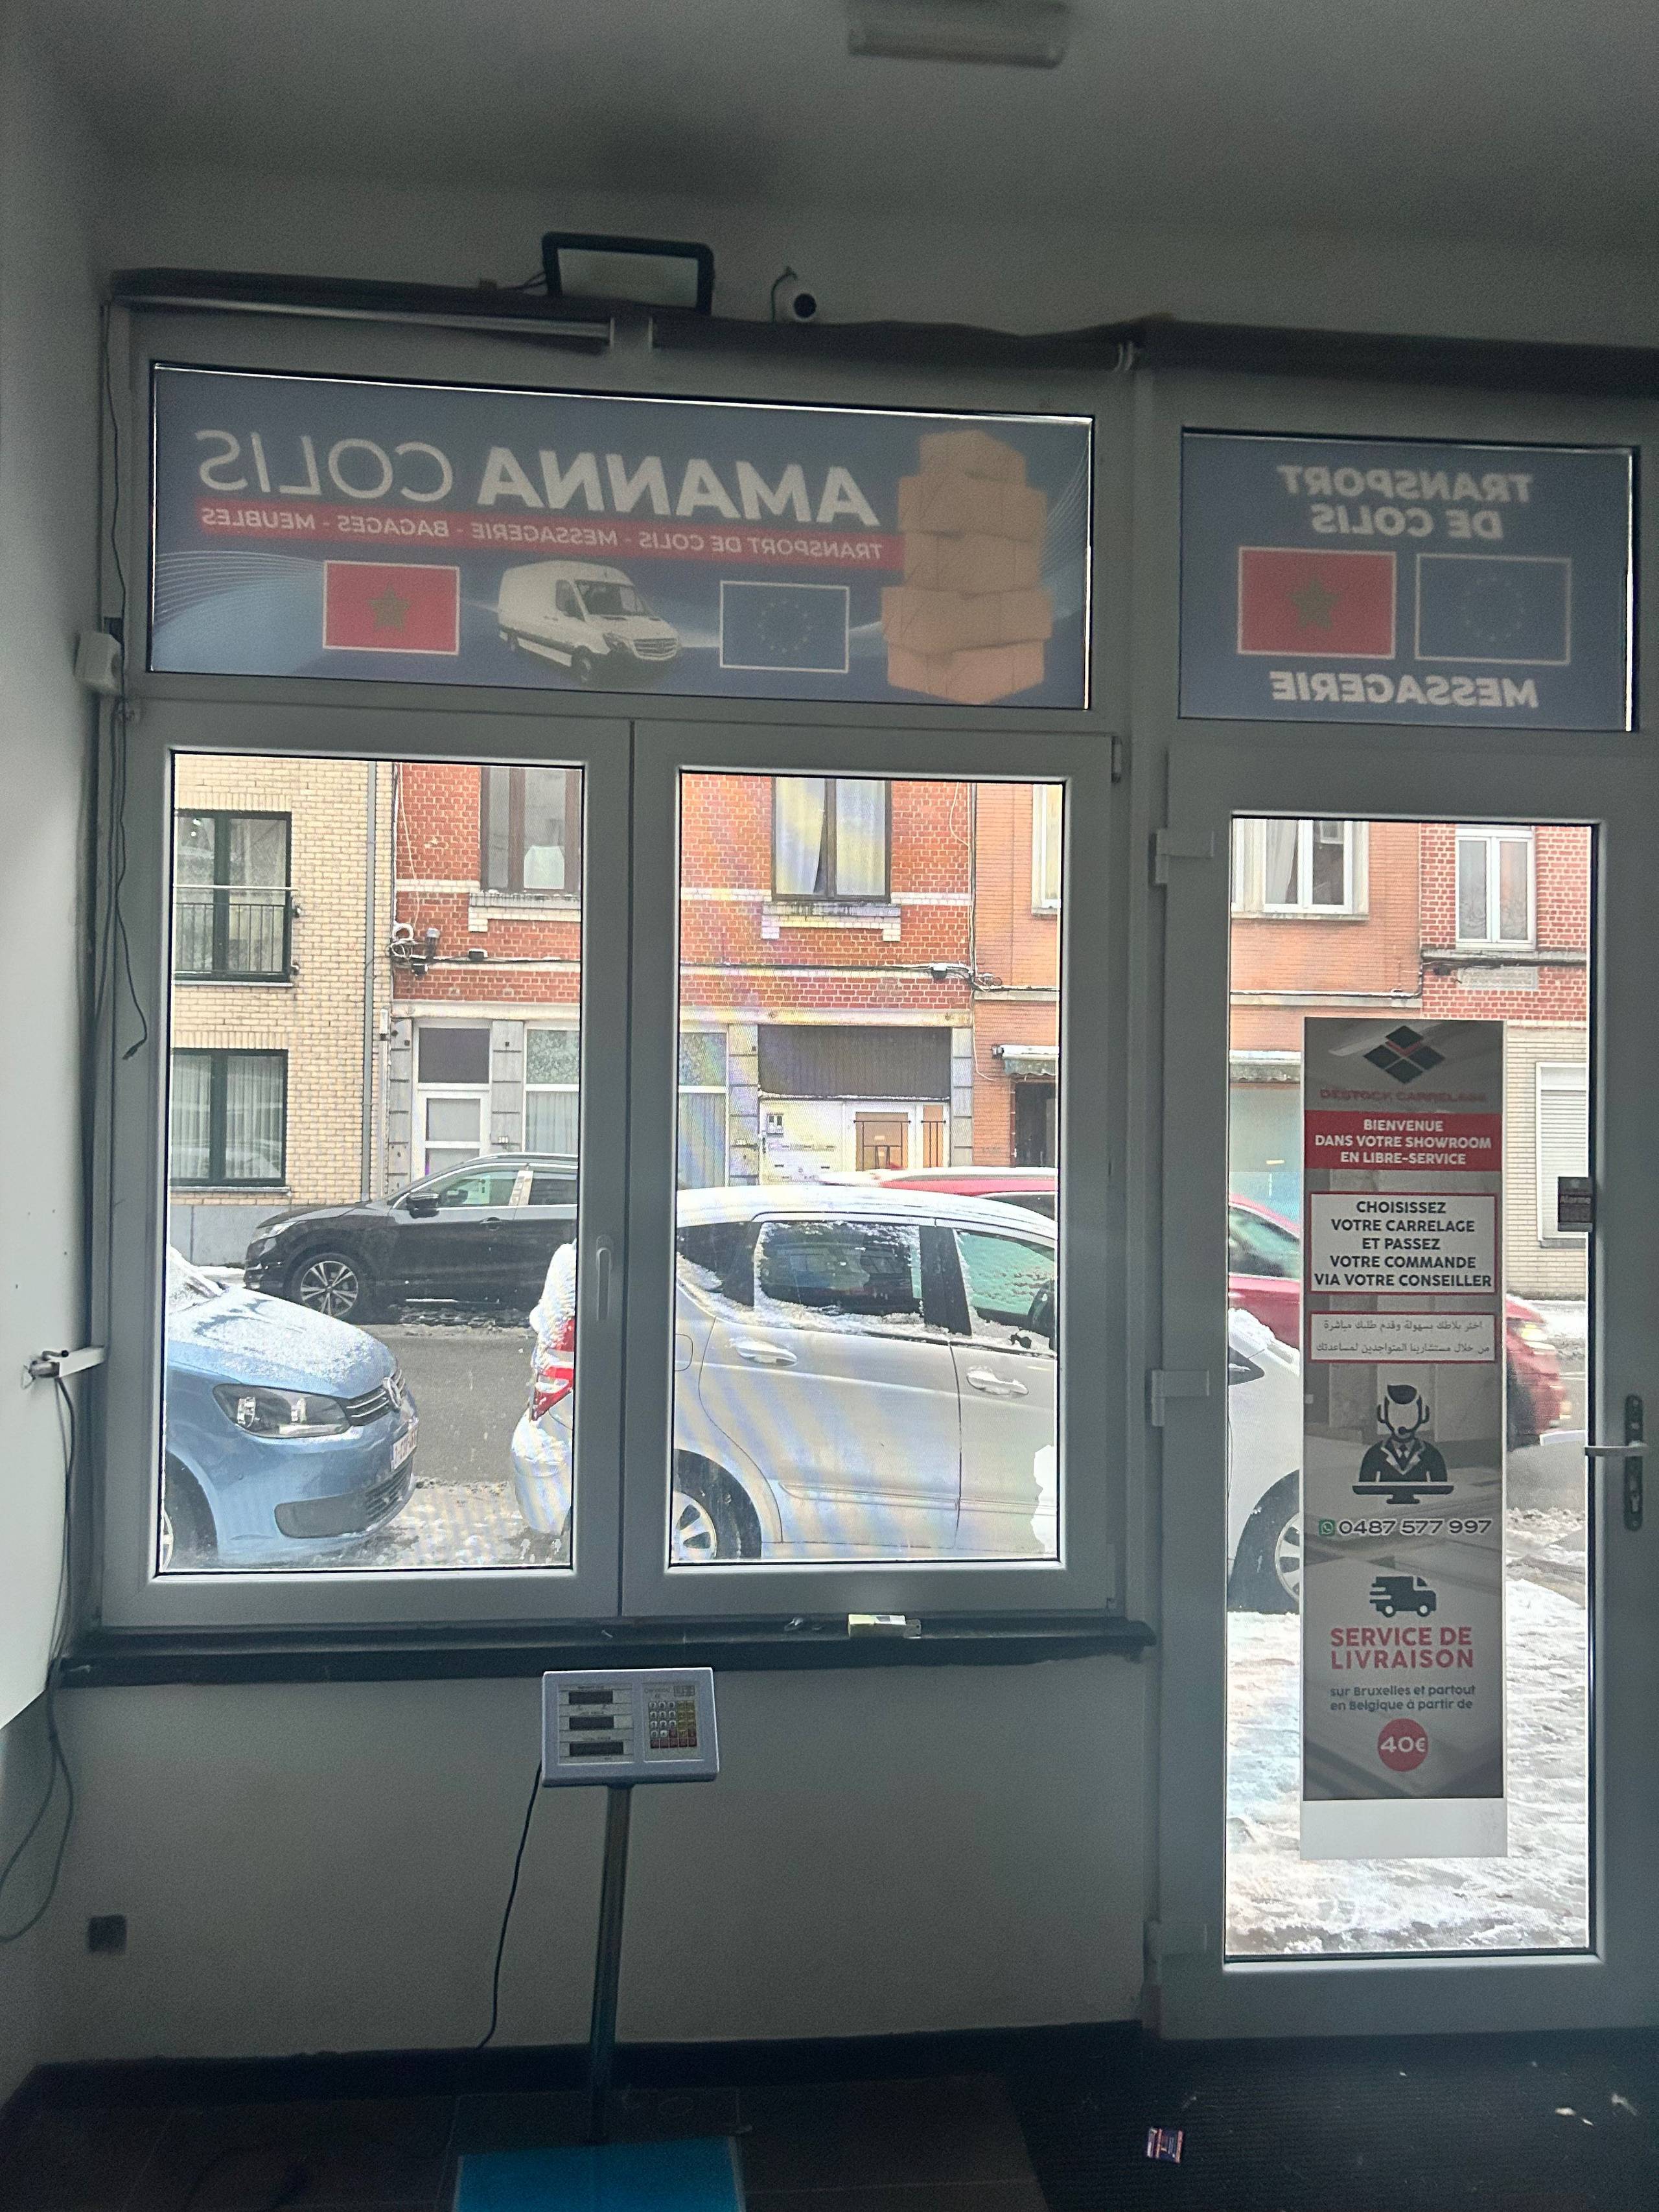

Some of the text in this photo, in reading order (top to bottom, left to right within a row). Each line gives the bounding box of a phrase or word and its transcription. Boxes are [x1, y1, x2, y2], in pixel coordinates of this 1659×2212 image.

[1363, 1119, 1444, 1132] BIENVENUE
[1315, 1135, 1491, 1148] DANS VOTRE SHOWROOM
[1340, 1151, 1466, 1165] EN LIBRE-SERVICE
[1356, 1201, 1446, 1214] CHOISISSEZ
[1331, 1218, 1475, 1232] VOTRE CARRELAGE
[1362, 1237, 1441, 1250] ET PASSEZ
[1330, 1255, 1476, 1268] VOTRE COMMANDE
[1314, 1274, 1492, 1287] VIA VOTRE CONSEILLER
[1338, 1519, 1492, 1534] 0487 577 997
[1330, 1626, 1472, 1647] SERVICE DE
[1331, 1649, 1474, 1670] LIVRAISON
[1330, 1685, 1476, 1697] sur Bruxelles et partout
[1330, 1699, 1473, 1712] en Belgique à partir de
[1380, 1736, 1427, 1752] 40€
